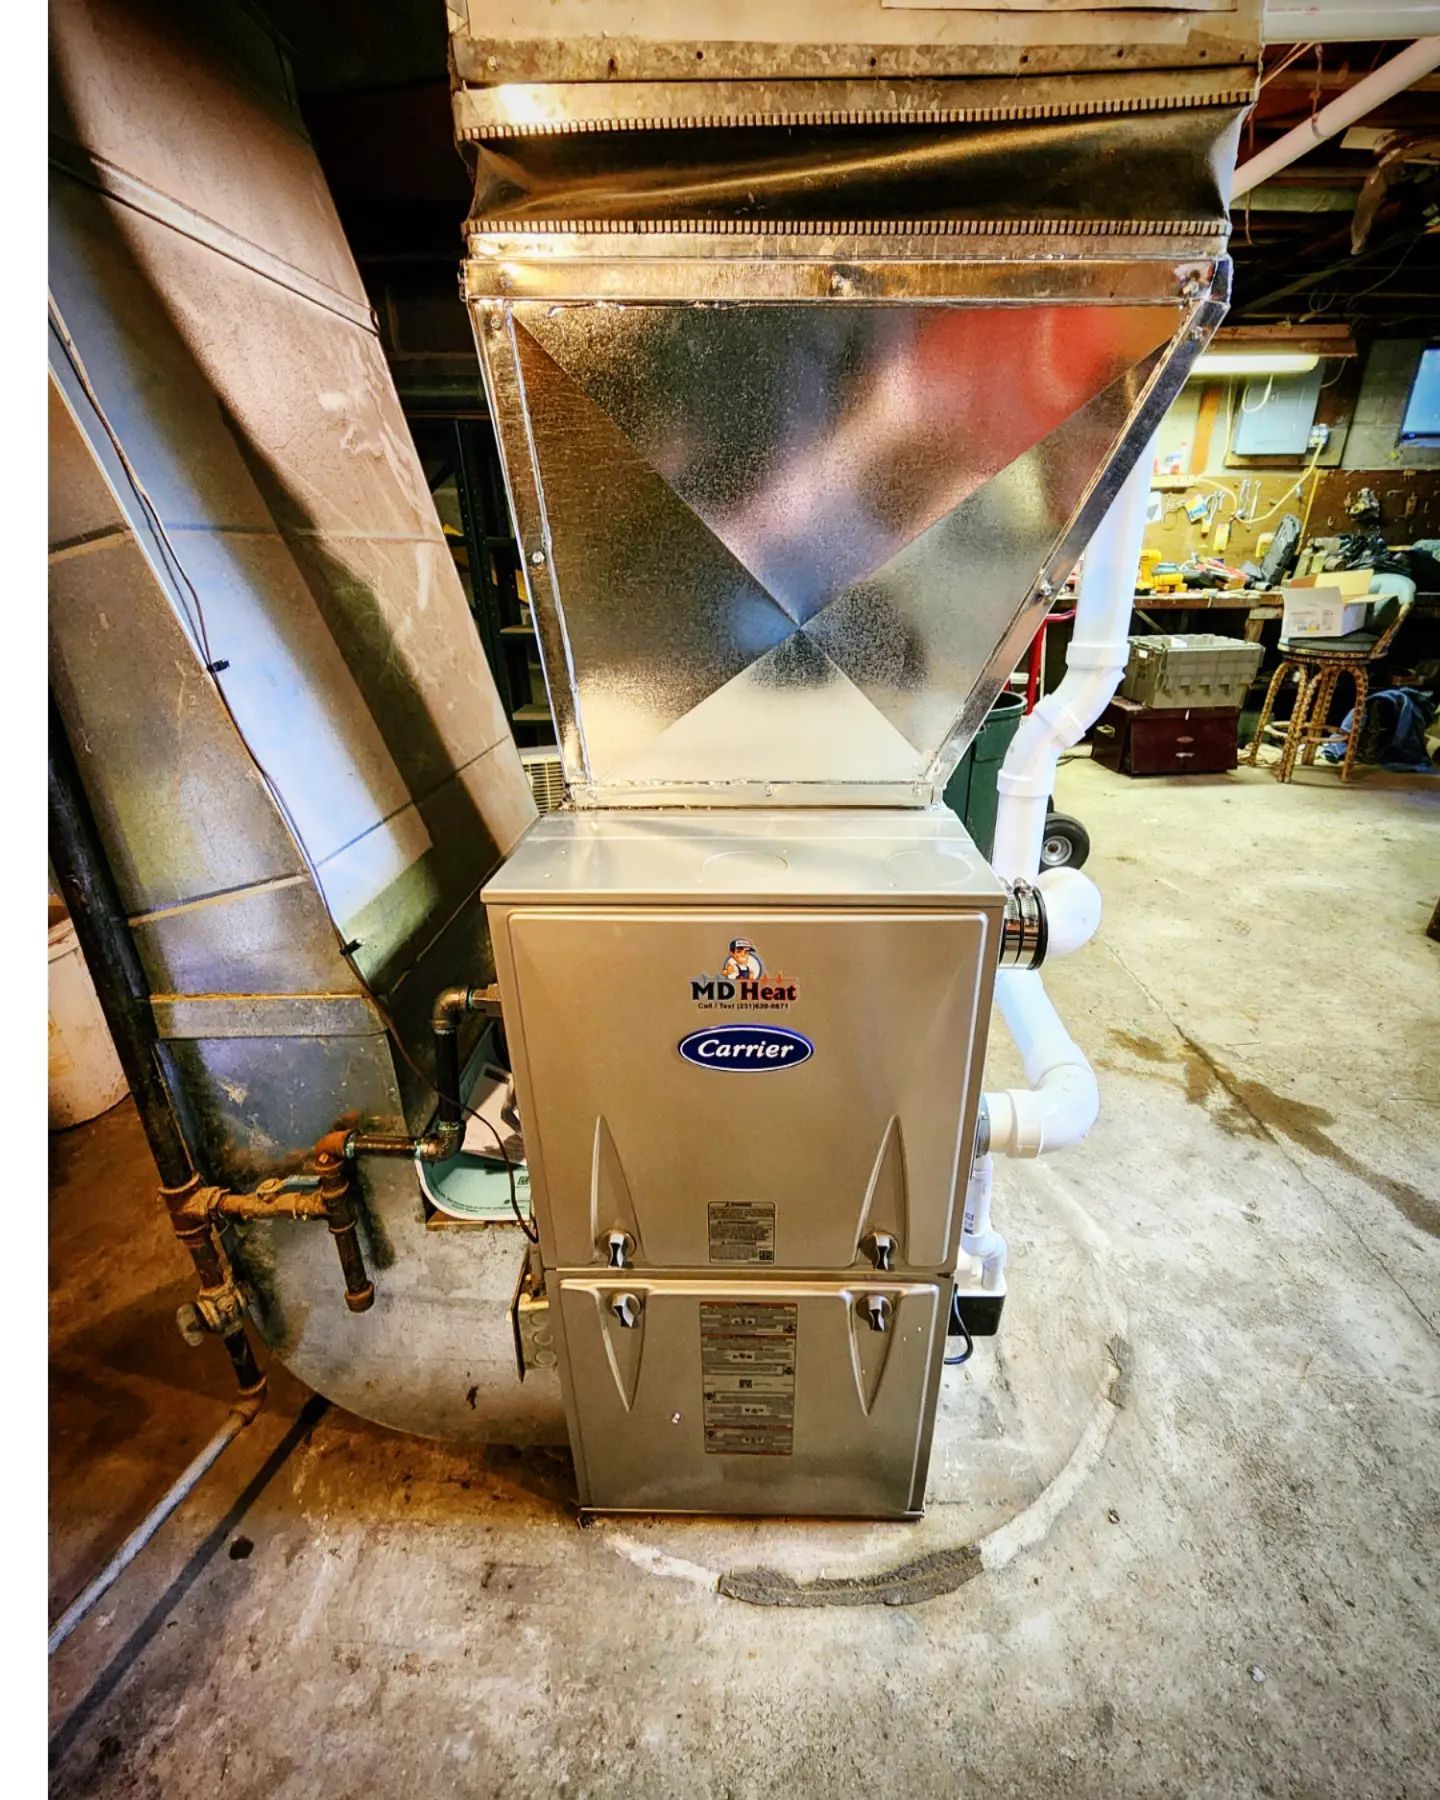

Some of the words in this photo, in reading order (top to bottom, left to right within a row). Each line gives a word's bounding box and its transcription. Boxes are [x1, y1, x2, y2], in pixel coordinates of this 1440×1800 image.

[691, 981, 735, 1000] MD
[741, 981, 797, 1001] Heat
[697, 1039, 794, 1058] Carrier
